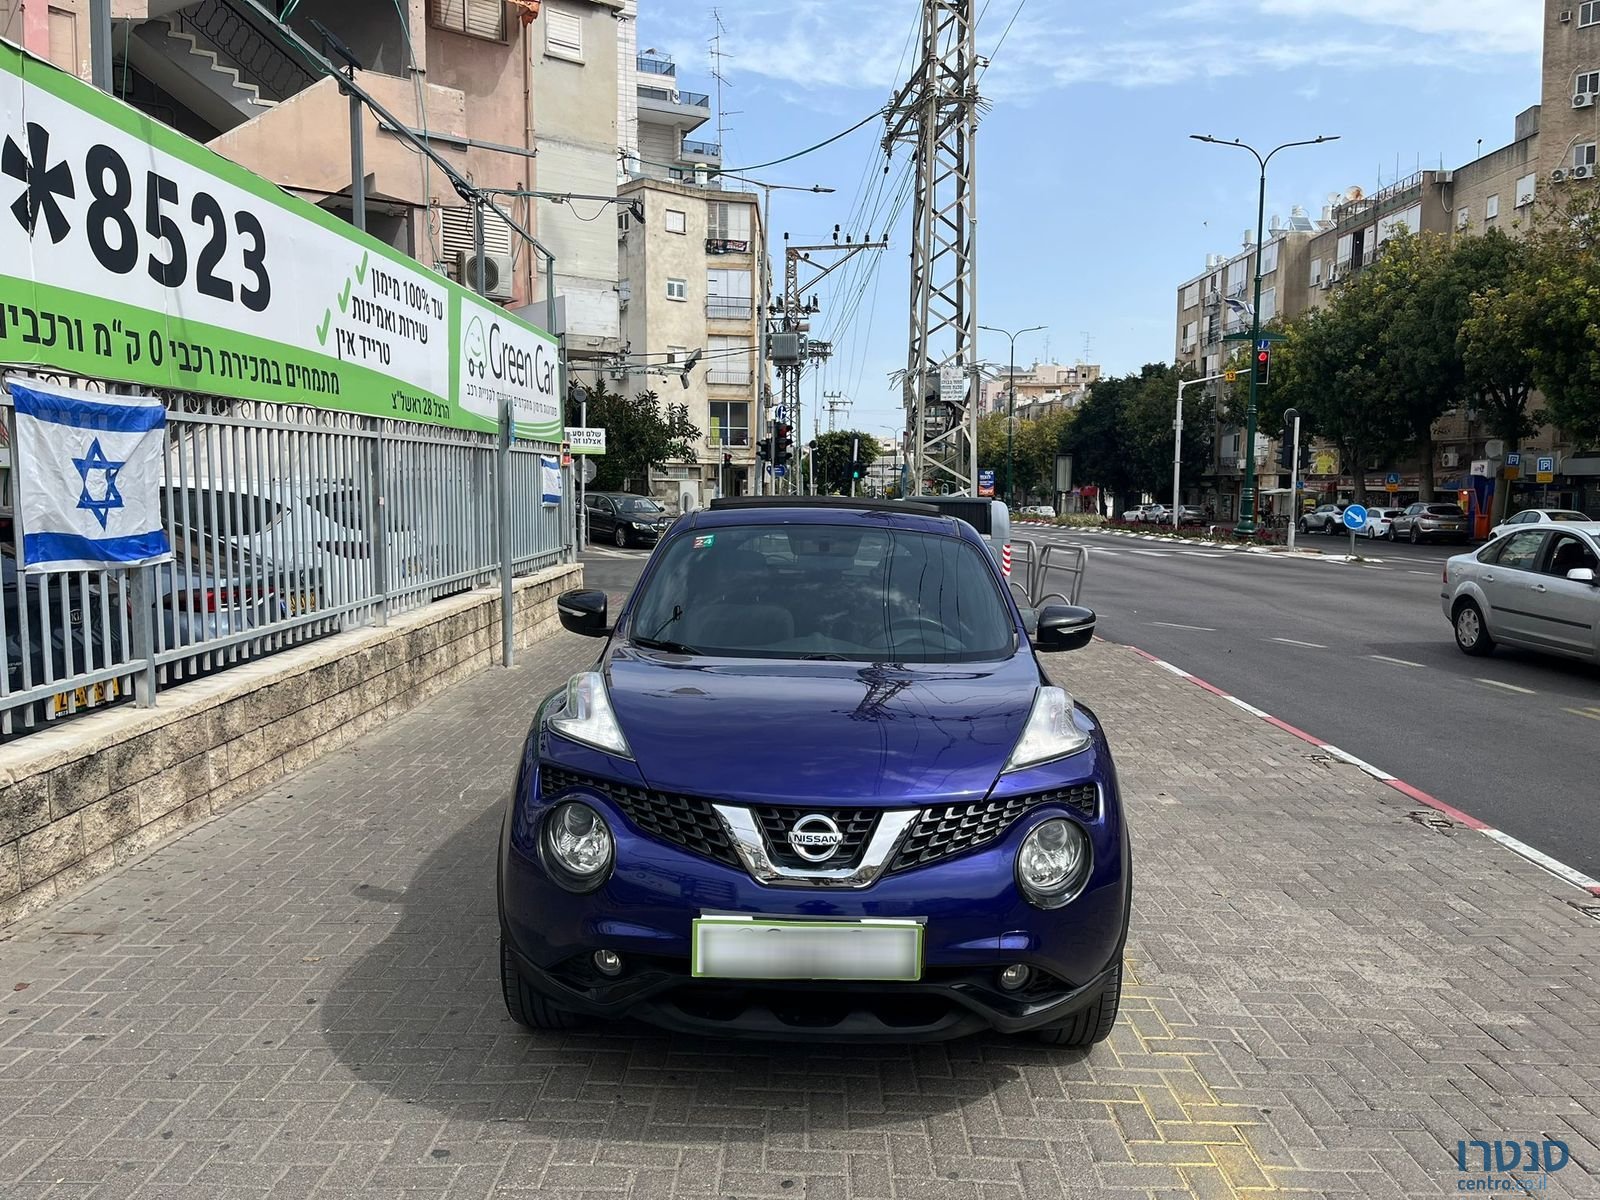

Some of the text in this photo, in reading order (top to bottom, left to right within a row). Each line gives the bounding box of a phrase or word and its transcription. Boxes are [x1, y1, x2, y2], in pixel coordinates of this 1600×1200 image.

[371, 268, 443, 320] עד 100% מימון
[352, 295, 428, 345] שירות ואמינות
[149, 329, 163, 366] 0
[169, 340, 215, 375] רכבי
[336, 328, 391, 365] טרייד אין
[489, 322, 555, 396] Green Car
[219, 350, 282, 386] במכירת
[285, 363, 340, 394] מתמחים
[422, 397, 432, 416] 28
[466, 384, 478, 397] רכב
[433, 398, 449, 420] הרצל
[793, 834, 838, 844] NISSAN
